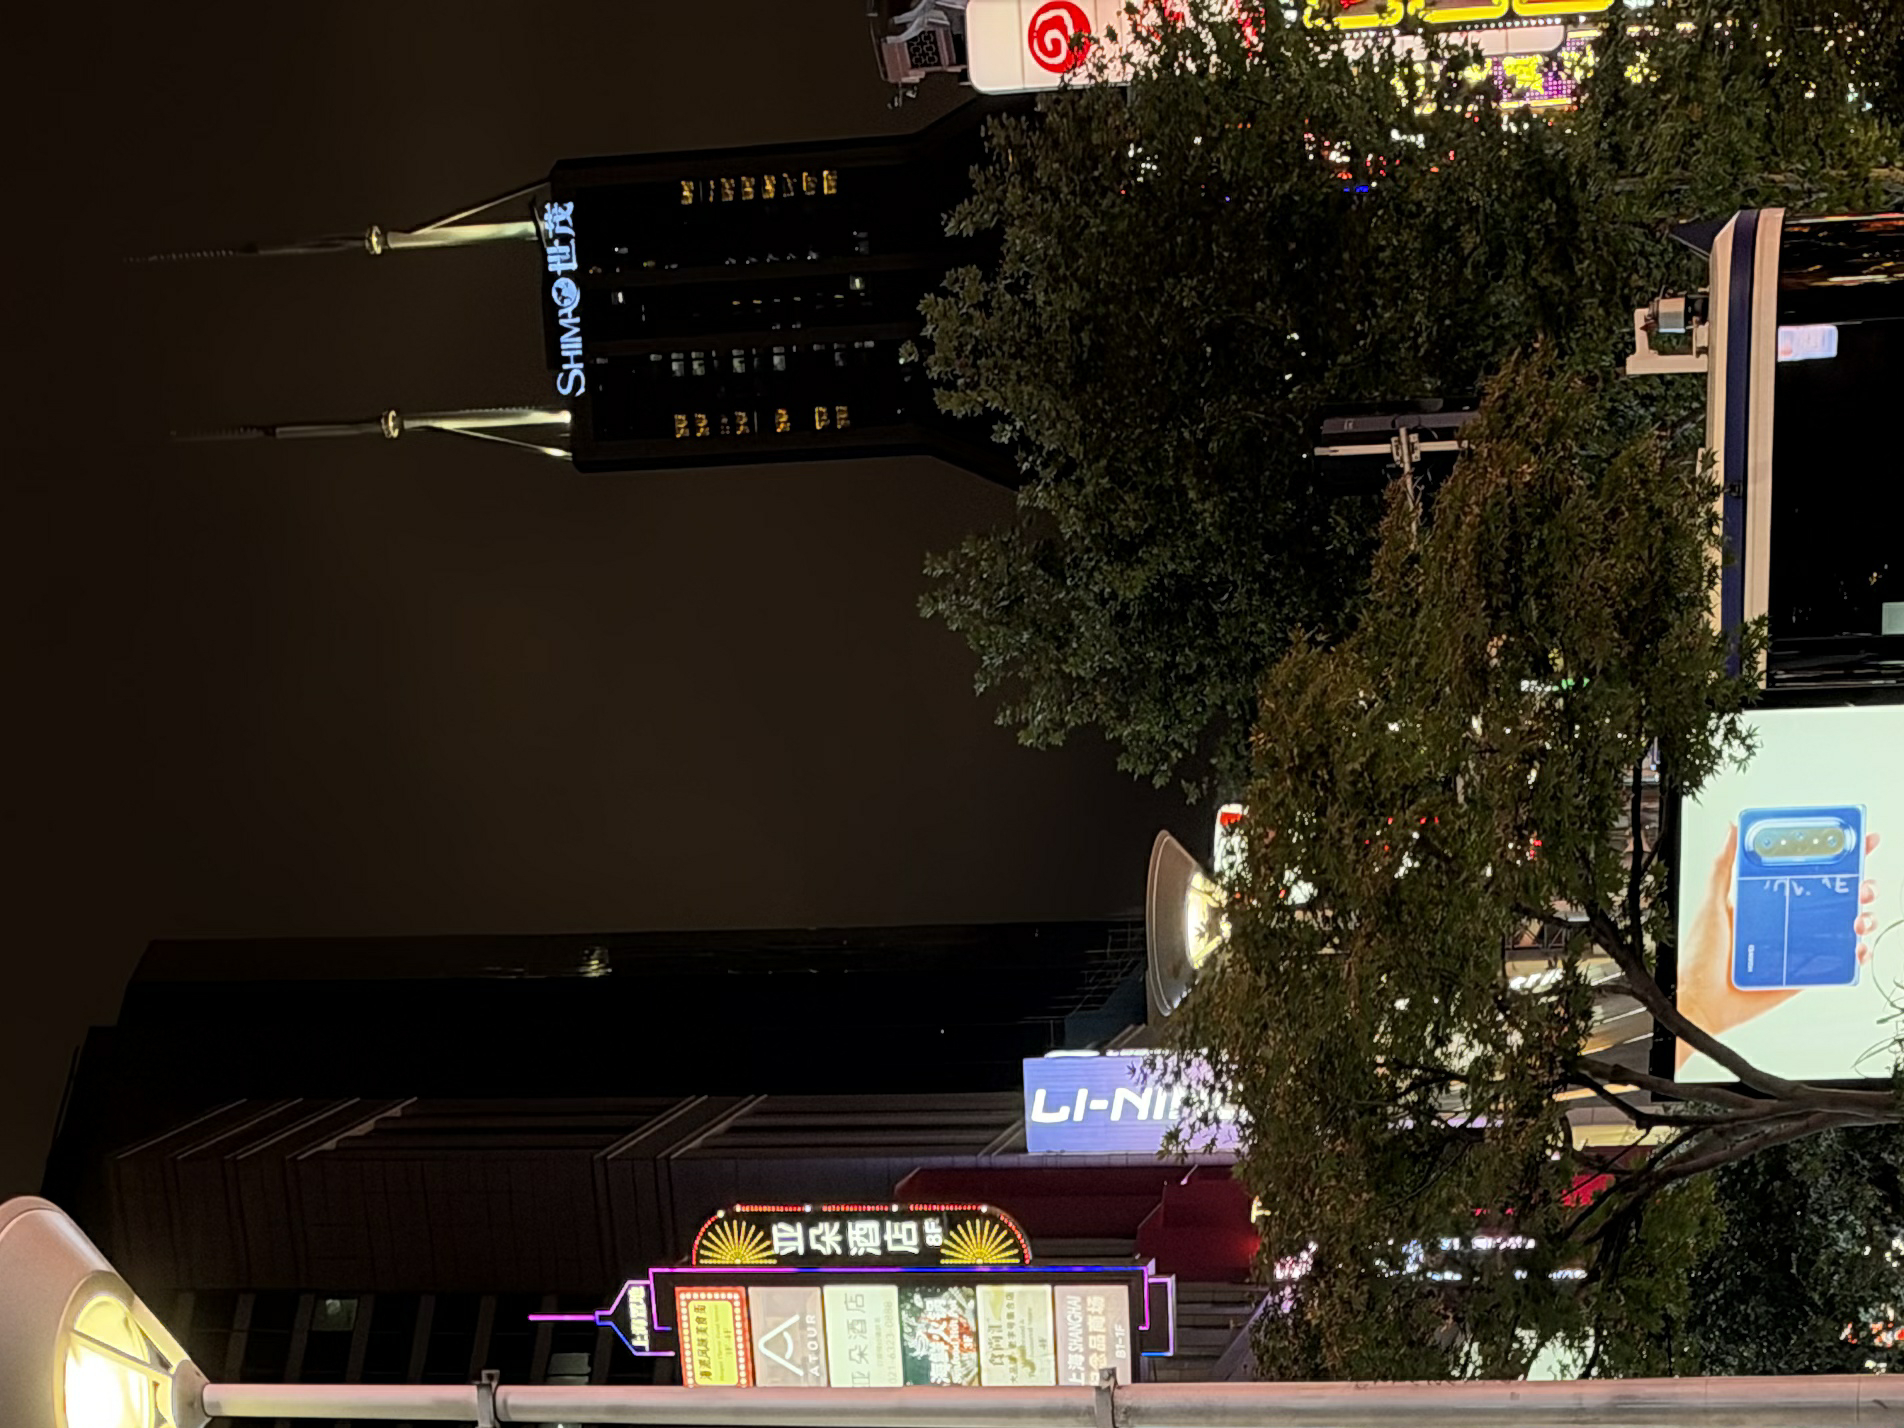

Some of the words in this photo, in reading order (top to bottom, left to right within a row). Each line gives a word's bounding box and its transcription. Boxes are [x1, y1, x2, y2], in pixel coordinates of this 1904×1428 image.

[544, 200, 578, 276] 世茂
[771, 1219, 919, 1256] 亚朵酒店
[923, 1218, 943, 1247] 8F
[805, 1314, 821, 1377] ATOUR
[844, 1292, 871, 1387] 亚朵酒店
[1066, 1295, 1084, 1353] SHANGHAI
[1067, 1353, 1085, 1386] 上海
